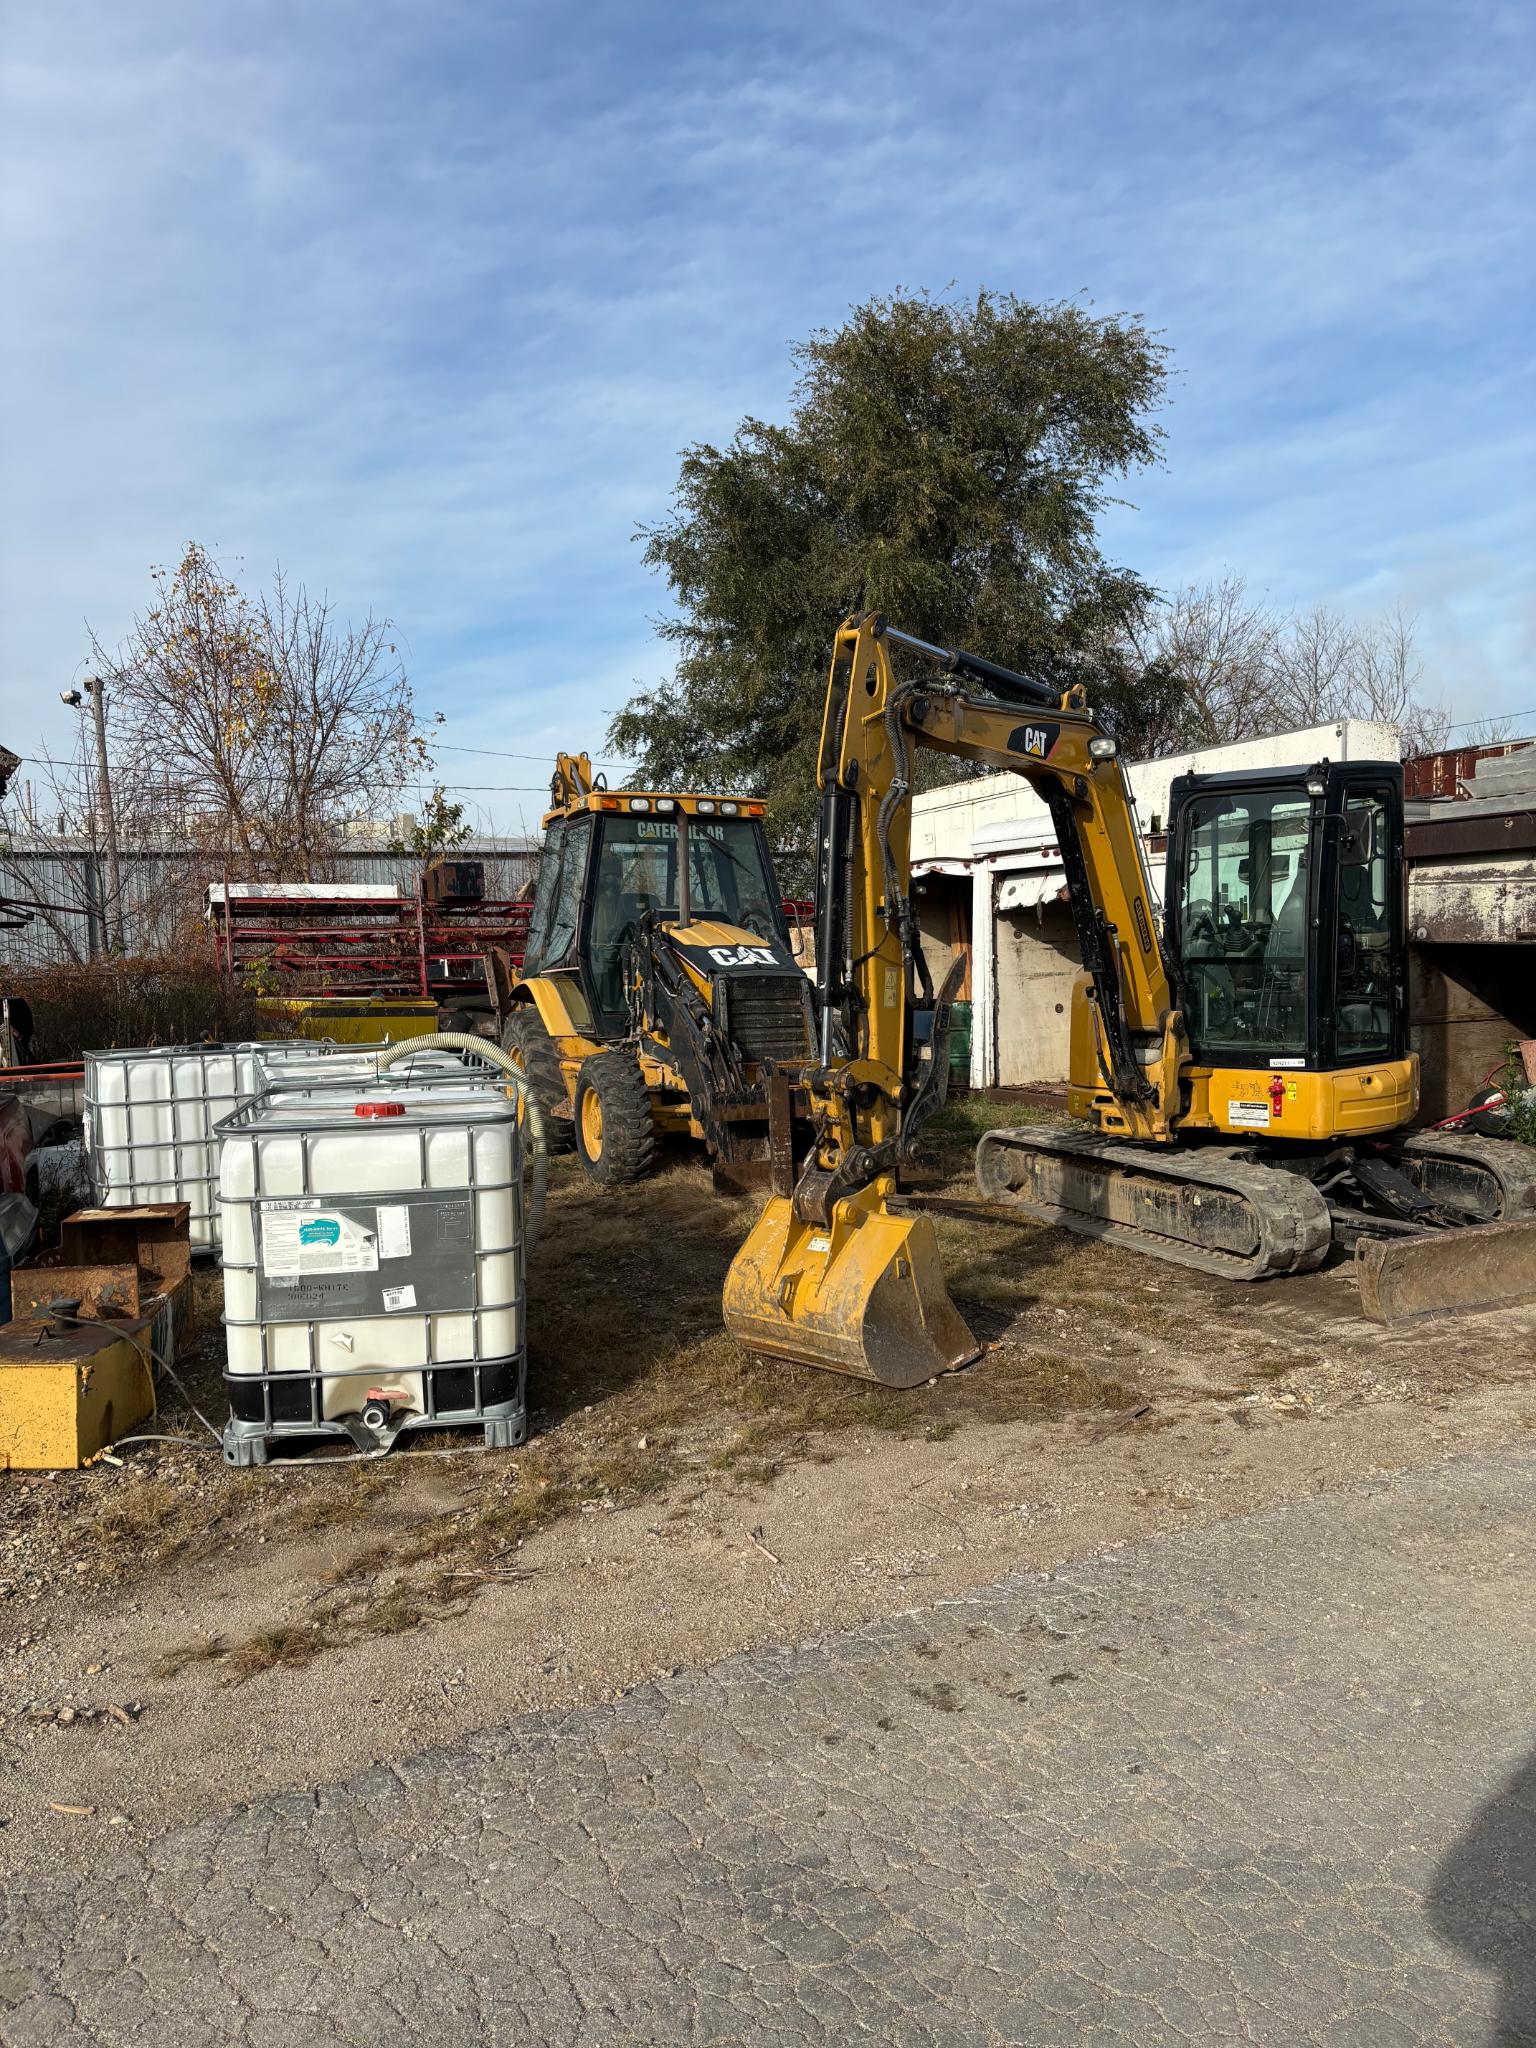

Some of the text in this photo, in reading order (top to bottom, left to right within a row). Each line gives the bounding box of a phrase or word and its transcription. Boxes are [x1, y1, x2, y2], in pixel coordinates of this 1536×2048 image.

[1025, 727, 1047, 757] CAT
[637, 822, 724, 841] CATERILLAR
[708, 946, 780, 966] CAT
